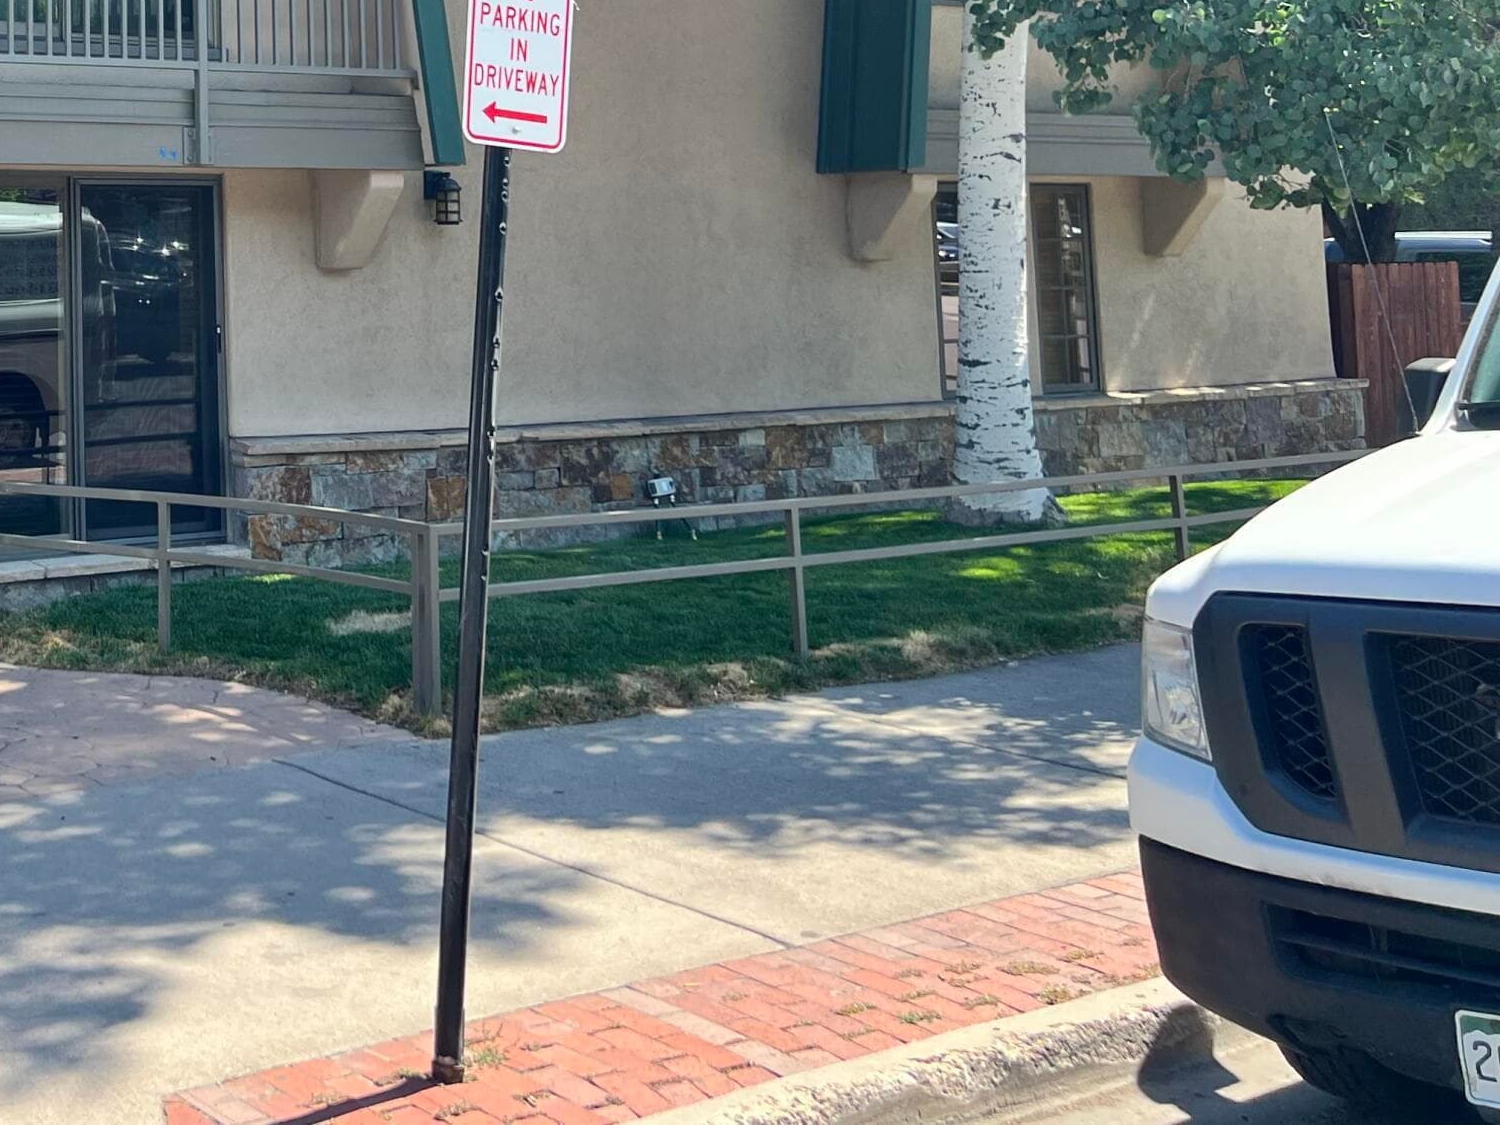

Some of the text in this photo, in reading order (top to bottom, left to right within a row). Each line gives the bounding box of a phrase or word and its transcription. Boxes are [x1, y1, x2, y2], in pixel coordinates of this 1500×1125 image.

[480, 2, 560, 36] PARKING
[510, 38, 528, 62] IN
[474, 63, 560, 97] DRIVEWAY
